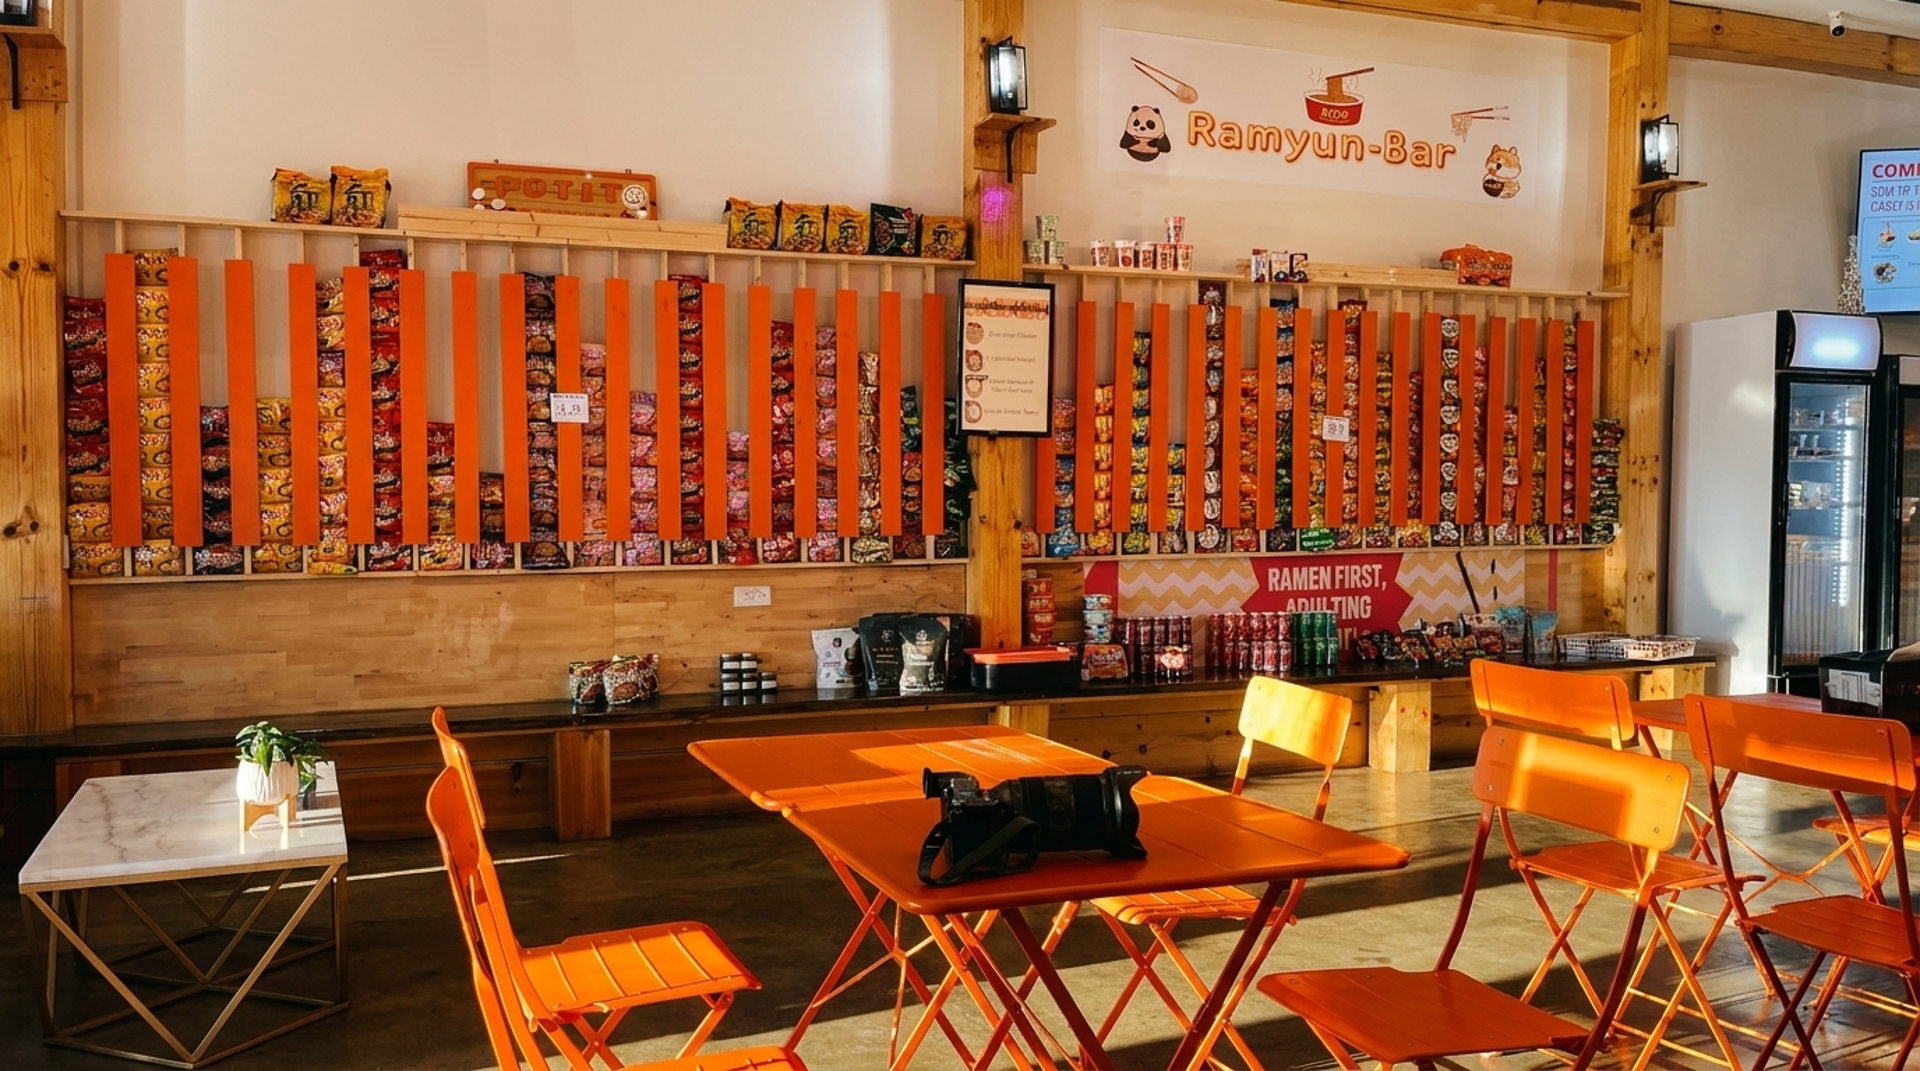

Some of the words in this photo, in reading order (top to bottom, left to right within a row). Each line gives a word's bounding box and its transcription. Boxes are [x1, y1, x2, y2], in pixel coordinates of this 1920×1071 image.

[1188, 110, 1457, 169] Ramyun-Bar
[1267, 566, 1331, 591] RAMEN
[1335, 564, 1387, 591] FIRST,
